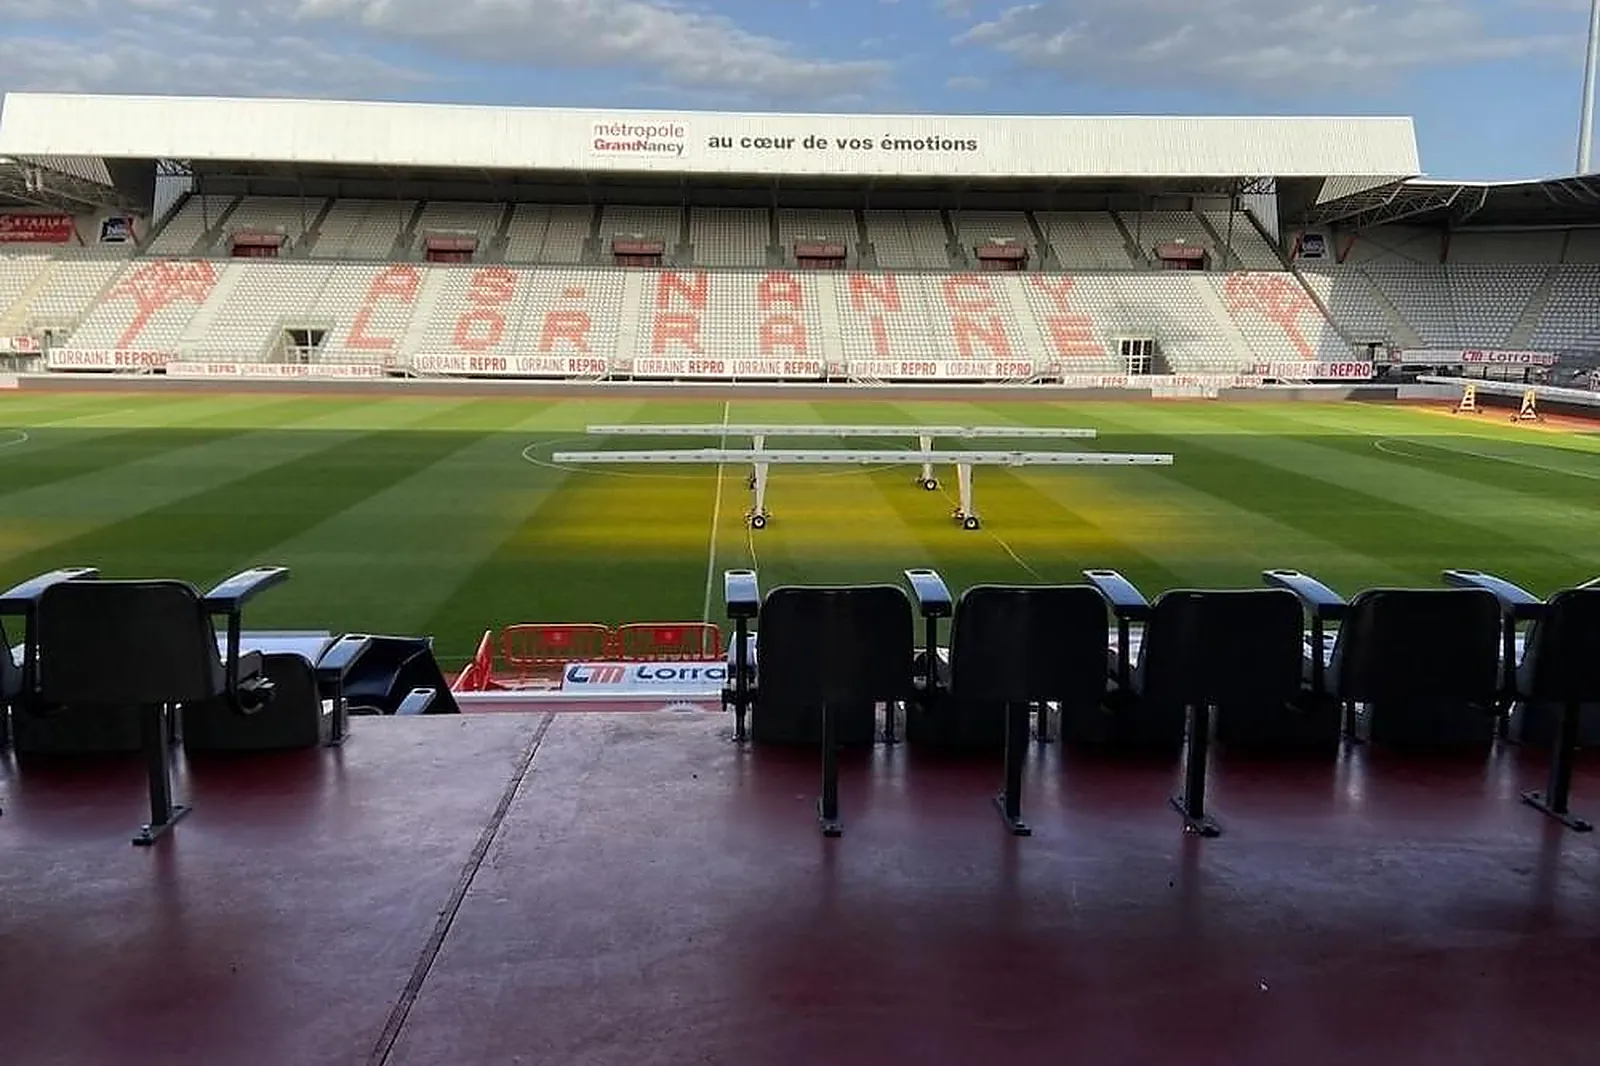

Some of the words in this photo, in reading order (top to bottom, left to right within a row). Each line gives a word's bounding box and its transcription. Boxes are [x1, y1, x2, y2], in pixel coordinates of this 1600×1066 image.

[594, 122, 685, 140] métropole
[708, 136, 733, 149] au
[740, 136, 796, 150] cœur
[802, 134, 828, 150] de
[836, 137, 874, 150] vos
[880, 133, 978, 151] émotions
[52, 350, 112, 365] LORRAINE
[469, 356, 507, 371] REPRO
[515, 357, 565, 372] LORRAINE
[568, 357, 605, 372] REPRO
[636, 359, 685, 374] LORRAINE
[688, 359, 725, 374] REPRO
[732, 359, 782, 375] LORRAINE
[784, 360, 819, 375] REPRO
[851, 361, 899, 375] LORRAINE
[901, 361, 937, 375] REPRO
[945, 362, 993, 376] LORRAINE
[995, 362, 1032, 376] REPRO
[1329, 362, 1370, 378] REPRO
